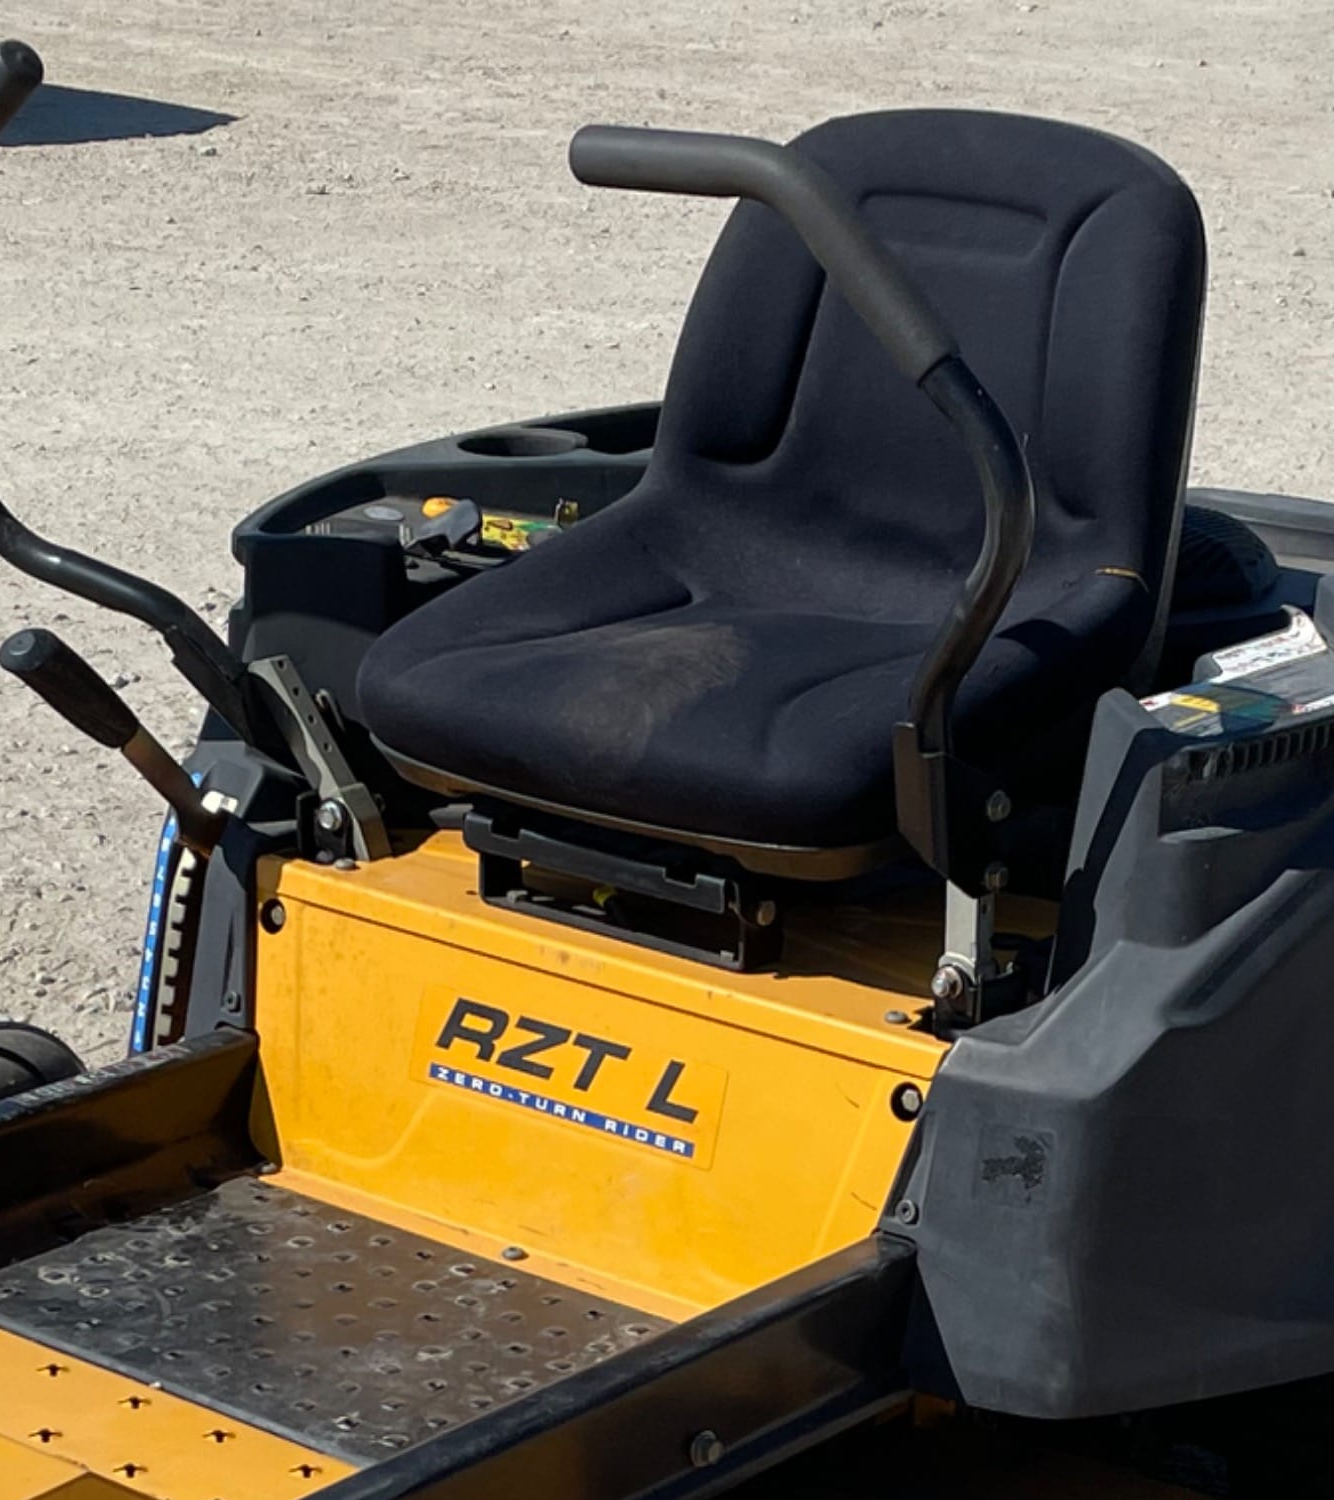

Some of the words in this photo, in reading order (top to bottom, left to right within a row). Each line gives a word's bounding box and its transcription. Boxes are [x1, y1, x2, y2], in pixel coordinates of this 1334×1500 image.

[435, 997, 632, 1092] RZT
[646, 1060, 699, 1124] L
[435, 1066, 586, 1123] ZERO-TURN
[605, 1118, 687, 1154] RIDER
